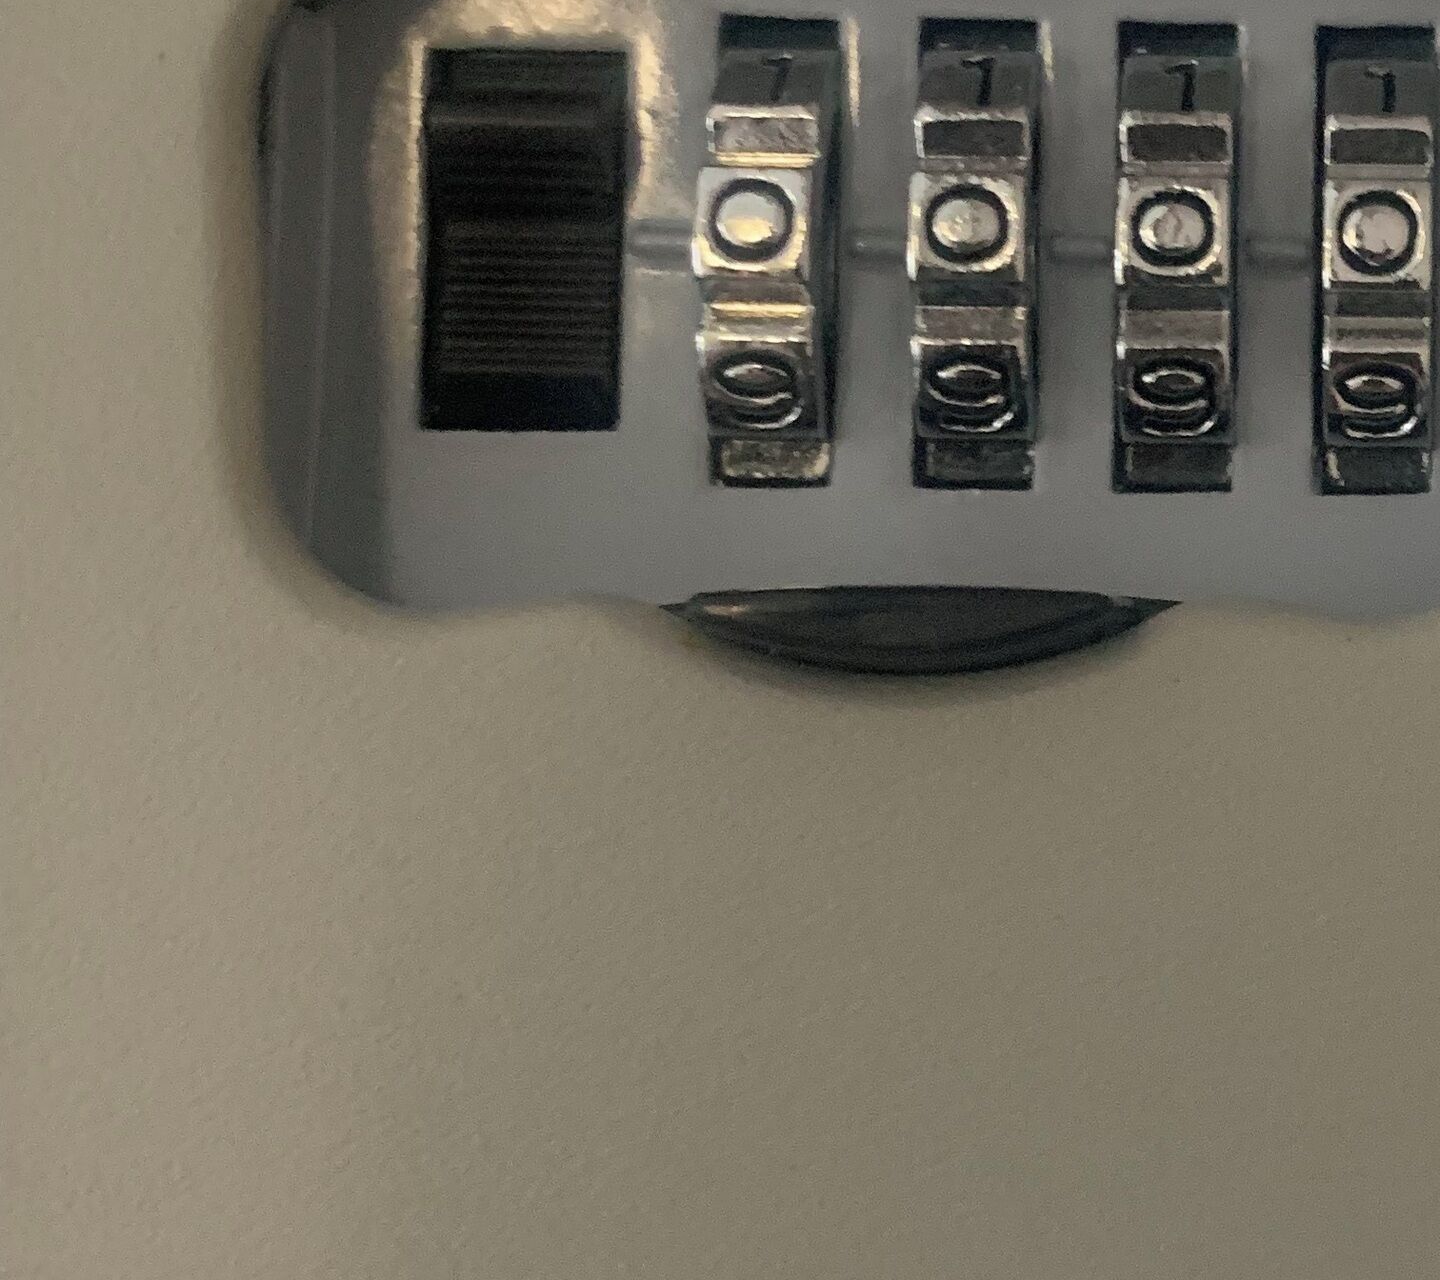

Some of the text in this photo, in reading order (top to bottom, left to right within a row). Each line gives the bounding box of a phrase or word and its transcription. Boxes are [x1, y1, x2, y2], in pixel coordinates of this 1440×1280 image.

[762, 51, 1397, 113] 1 1 1 1
[709, 177, 1419, 276] 0 0 0 0
